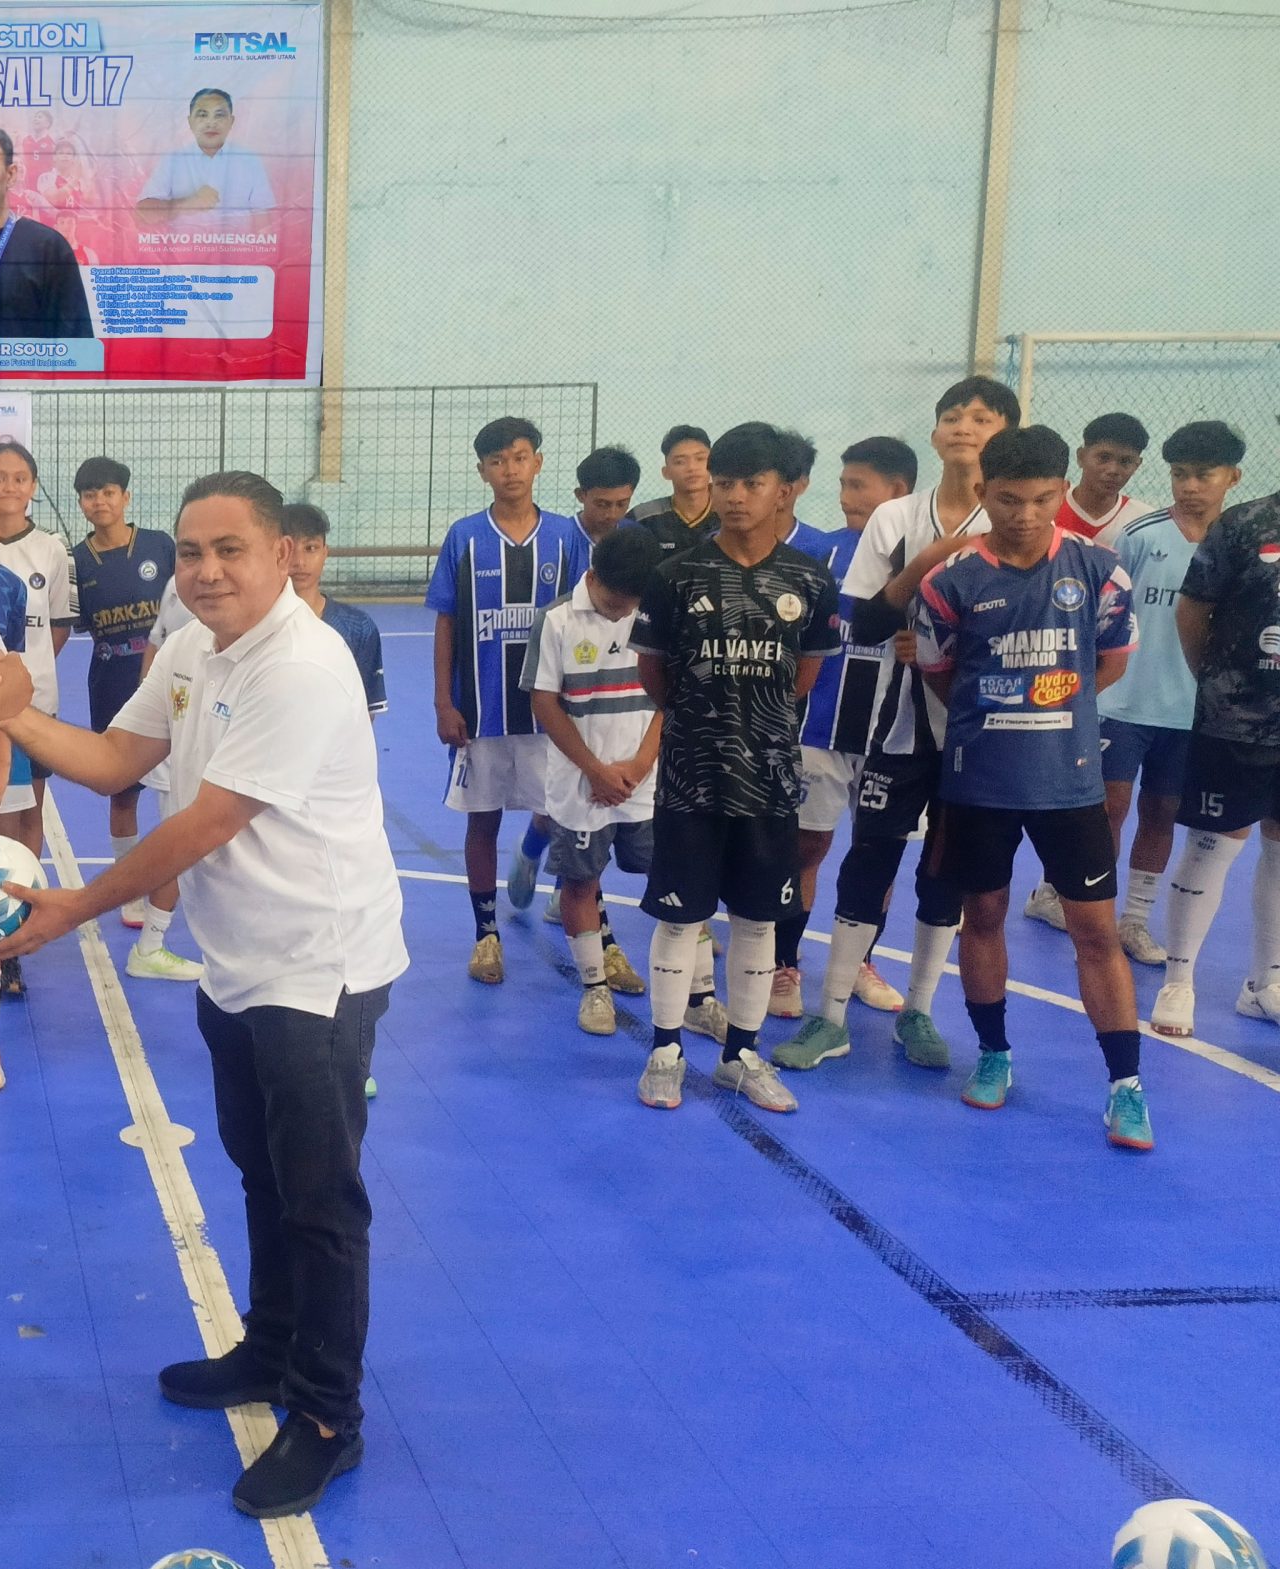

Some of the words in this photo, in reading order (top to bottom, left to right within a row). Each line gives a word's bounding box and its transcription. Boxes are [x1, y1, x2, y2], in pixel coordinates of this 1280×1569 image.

[194, 32, 296, 53] FUTSAL
[61, 56, 134, 107] U17
[138, 233, 190, 244] MEYVO
[193, 233, 277, 244] RUMENGAN
[90, 268, 115, 276] Syarat
[13, 343, 68, 356] SOUTO
[11, 358, 35, 366] Futsal
[37, 358, 77, 367] Indonesia
[988, 628, 1078, 655] SMANDEL
[714, 664, 771, 678] CLOTHING
[860, 780, 889, 810] 25
[1200, 791, 1225, 817] 15
[780, 878, 793, 905] 6
